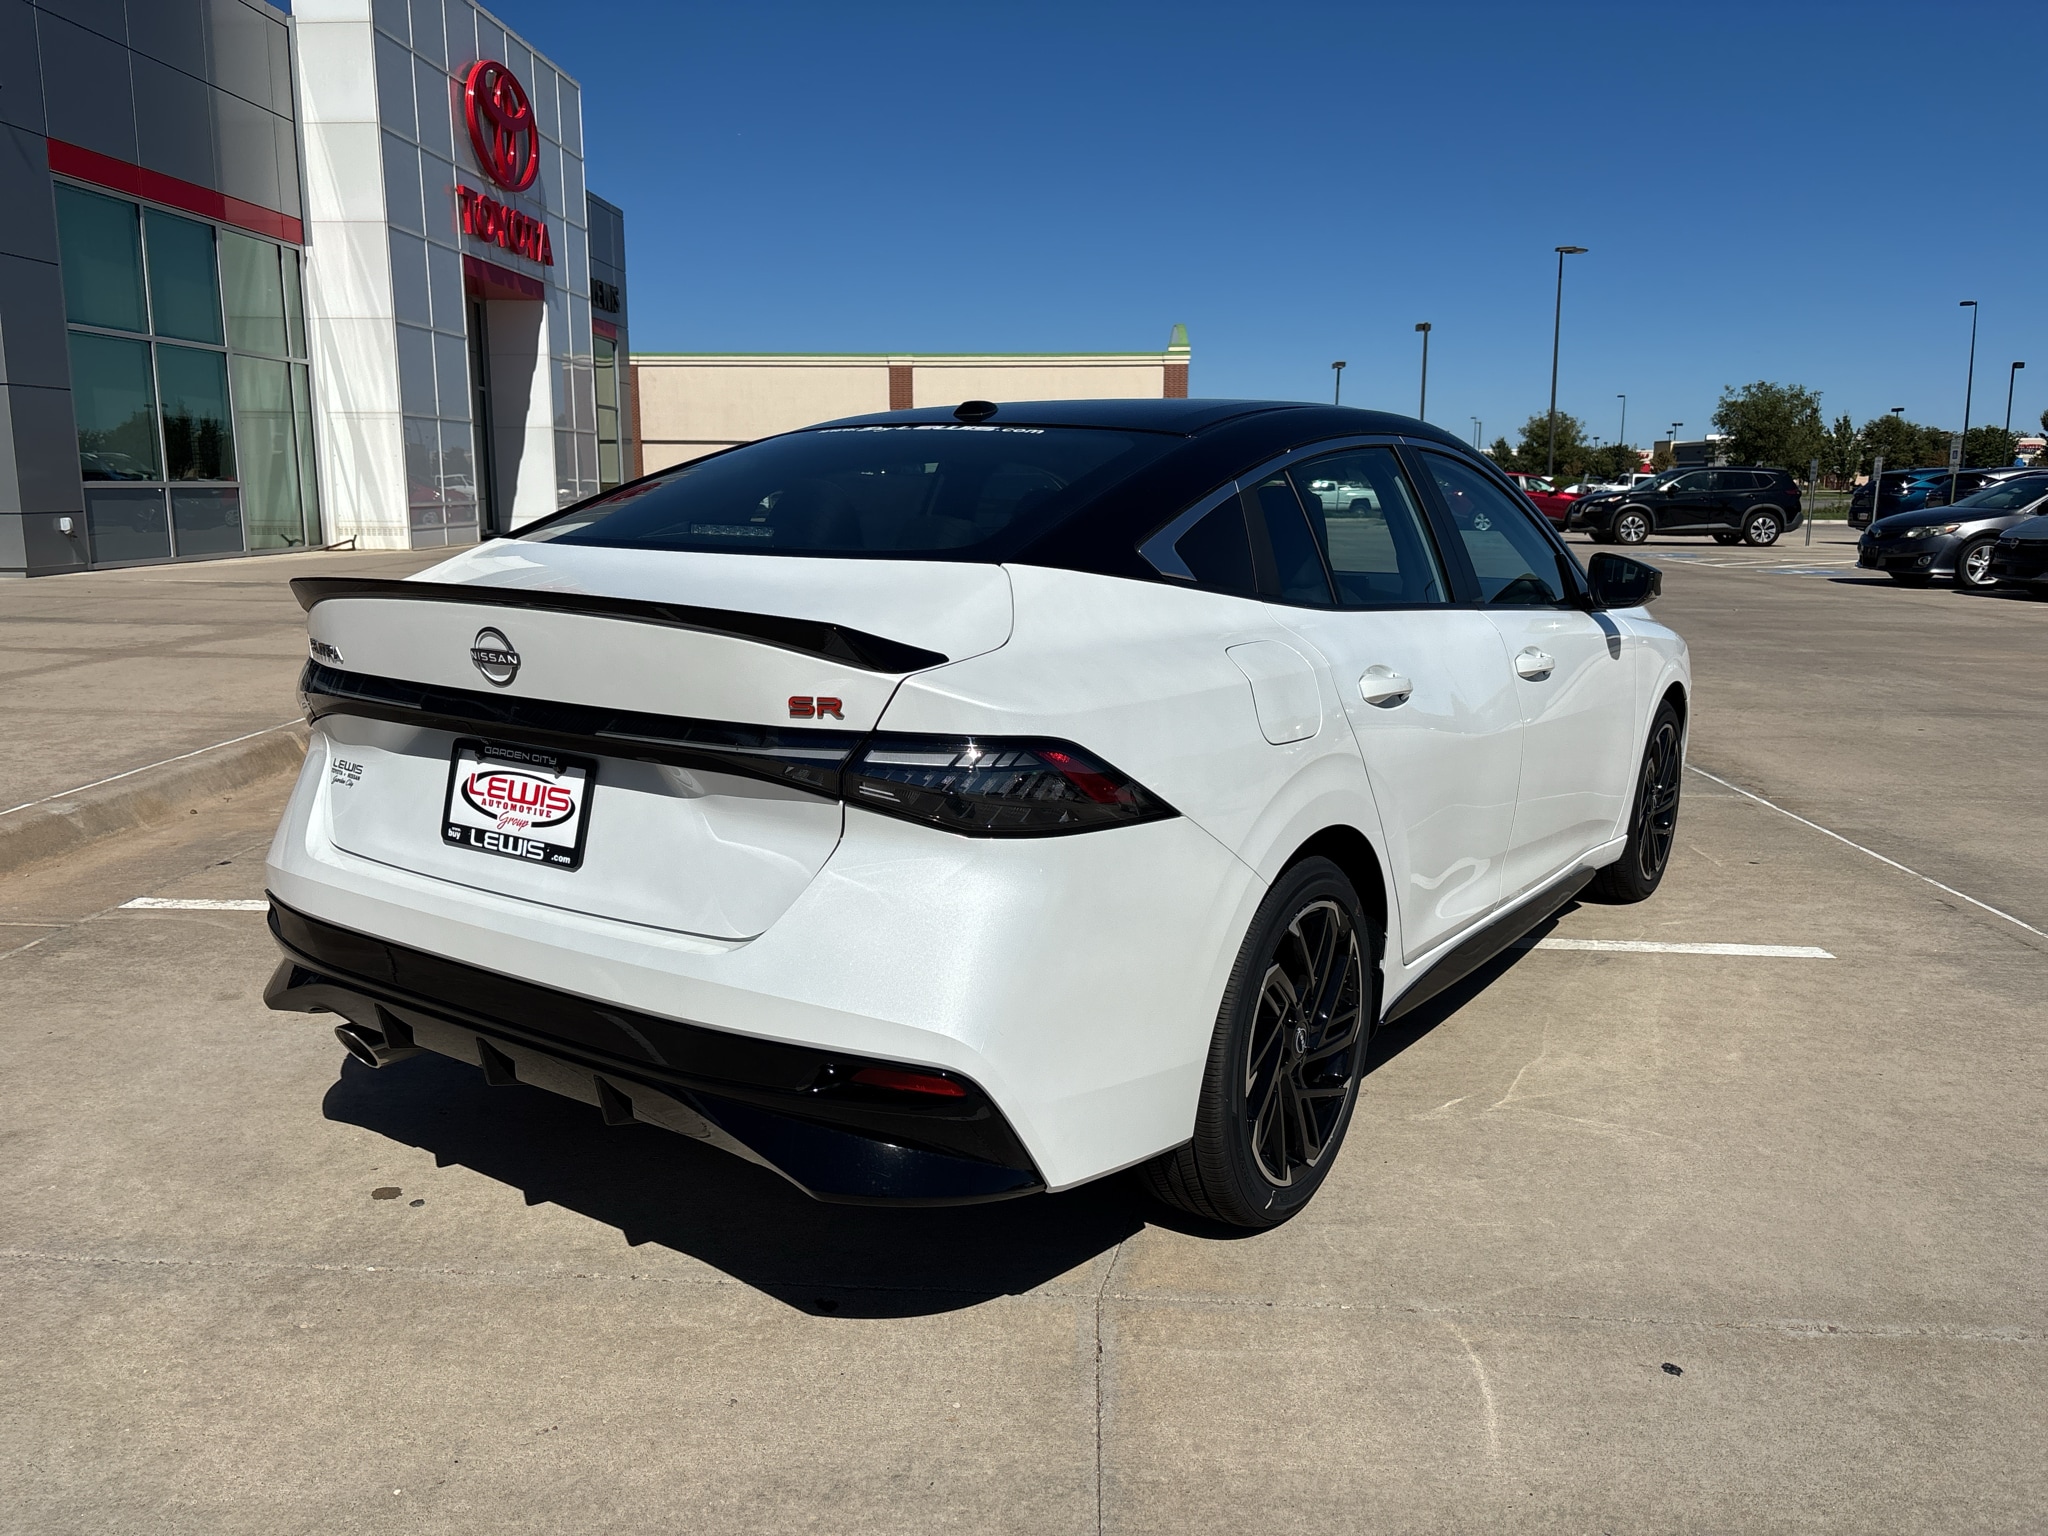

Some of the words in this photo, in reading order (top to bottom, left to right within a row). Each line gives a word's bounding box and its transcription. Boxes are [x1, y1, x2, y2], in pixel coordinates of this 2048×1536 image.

[456, 184, 554, 267] TOYOTA
[470, 650, 518, 664] NISSAN
[788, 696, 845, 720] SR
[333, 758, 364, 775] LEWIS
[484, 746, 531, 761] GARDEN
[532, 752, 557, 765] CITY
[468, 773, 571, 812] LEWIS
[481, 798, 552, 819] AUTOMOTIVE
[496, 810, 530, 832] Group
[448, 828, 461, 840] buy
[470, 828, 545, 860] LEWIS
[551, 854, 571, 864] .com
